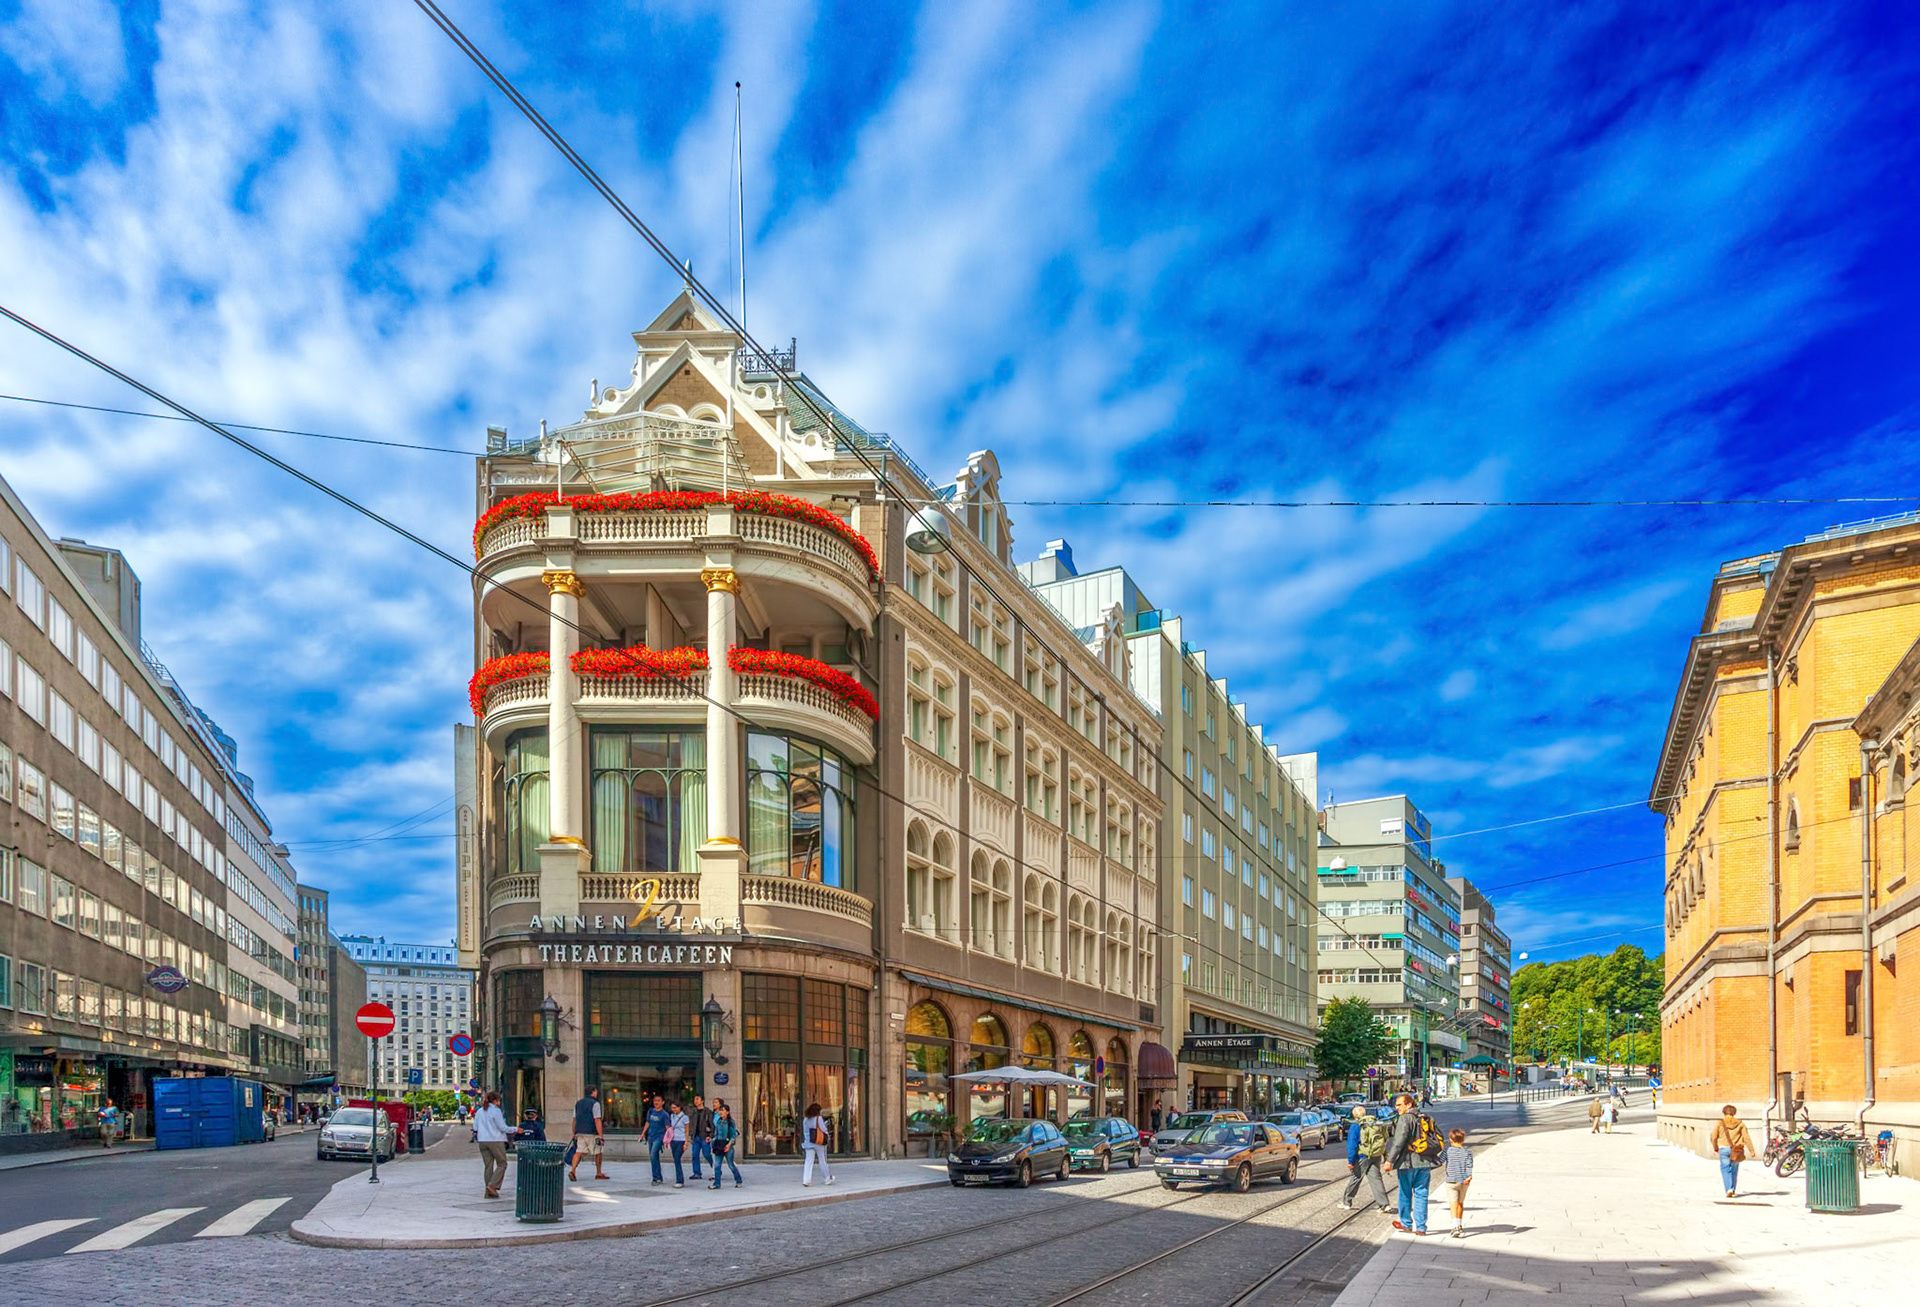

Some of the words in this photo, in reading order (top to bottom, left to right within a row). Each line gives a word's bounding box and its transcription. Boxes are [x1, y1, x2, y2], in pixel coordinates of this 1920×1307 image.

[461, 825, 471, 882] LIPP
[529, 914, 626, 929] ANNEN
[655, 915, 742, 930] ETAGE
[538, 944, 733, 964] THEATERCAFEEN
[411, 1071, 419, 1082] P
